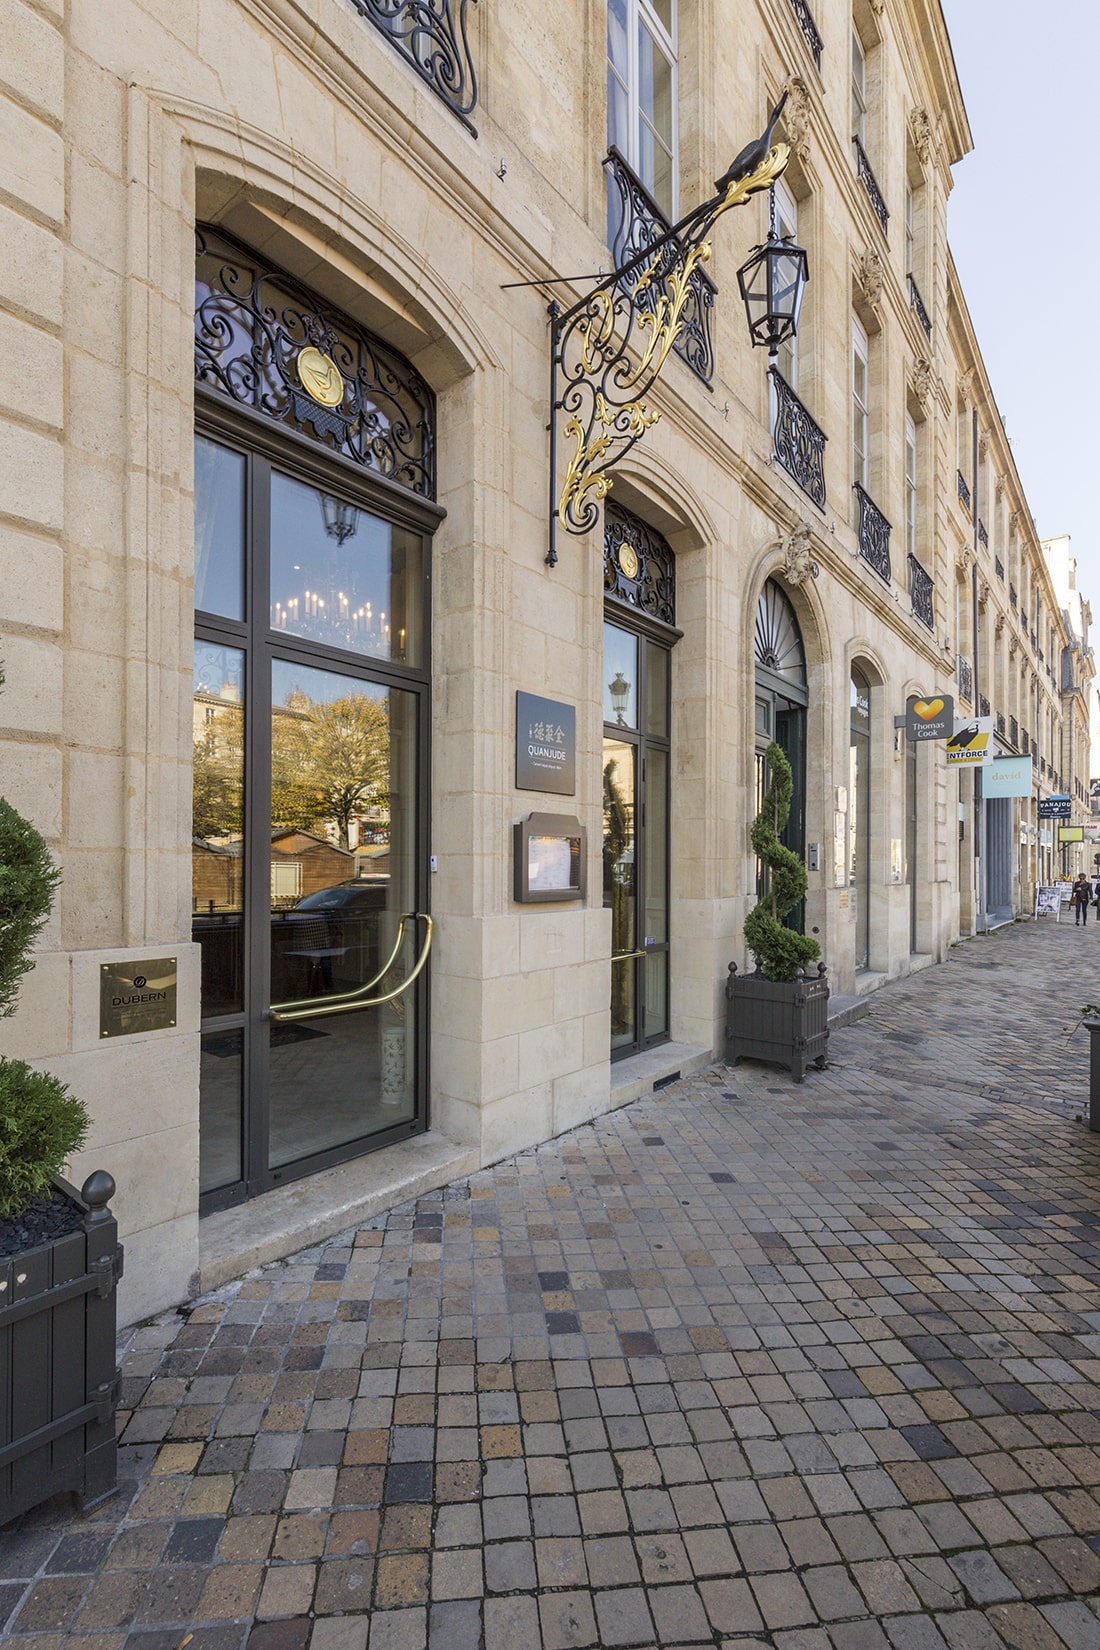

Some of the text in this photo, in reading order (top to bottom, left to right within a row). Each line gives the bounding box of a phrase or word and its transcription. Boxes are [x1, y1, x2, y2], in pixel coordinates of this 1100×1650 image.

[912, 722, 945, 731] Thomas
[917, 729, 938, 738] Cook
[527, 744, 566, 761] QUANJUDE
[991, 771, 1022, 781] david
[112, 991, 167, 1006] DUBERN
